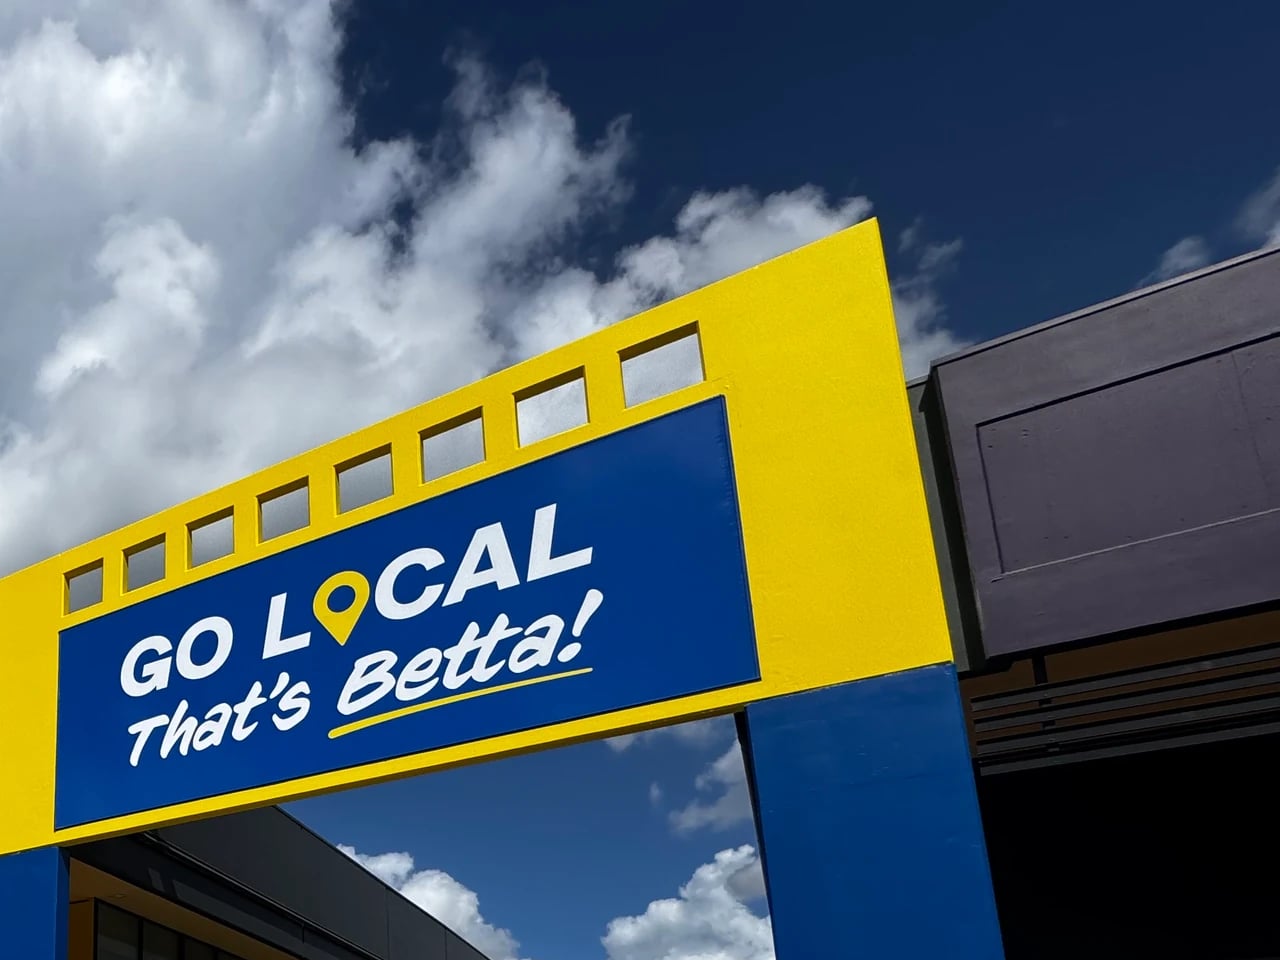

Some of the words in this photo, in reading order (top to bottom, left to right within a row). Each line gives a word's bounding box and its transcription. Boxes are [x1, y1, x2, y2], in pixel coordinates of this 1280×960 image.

[120, 615, 233, 697] GO
[127, 671, 311, 767] That's
[336, 588, 604, 716] Betta!
